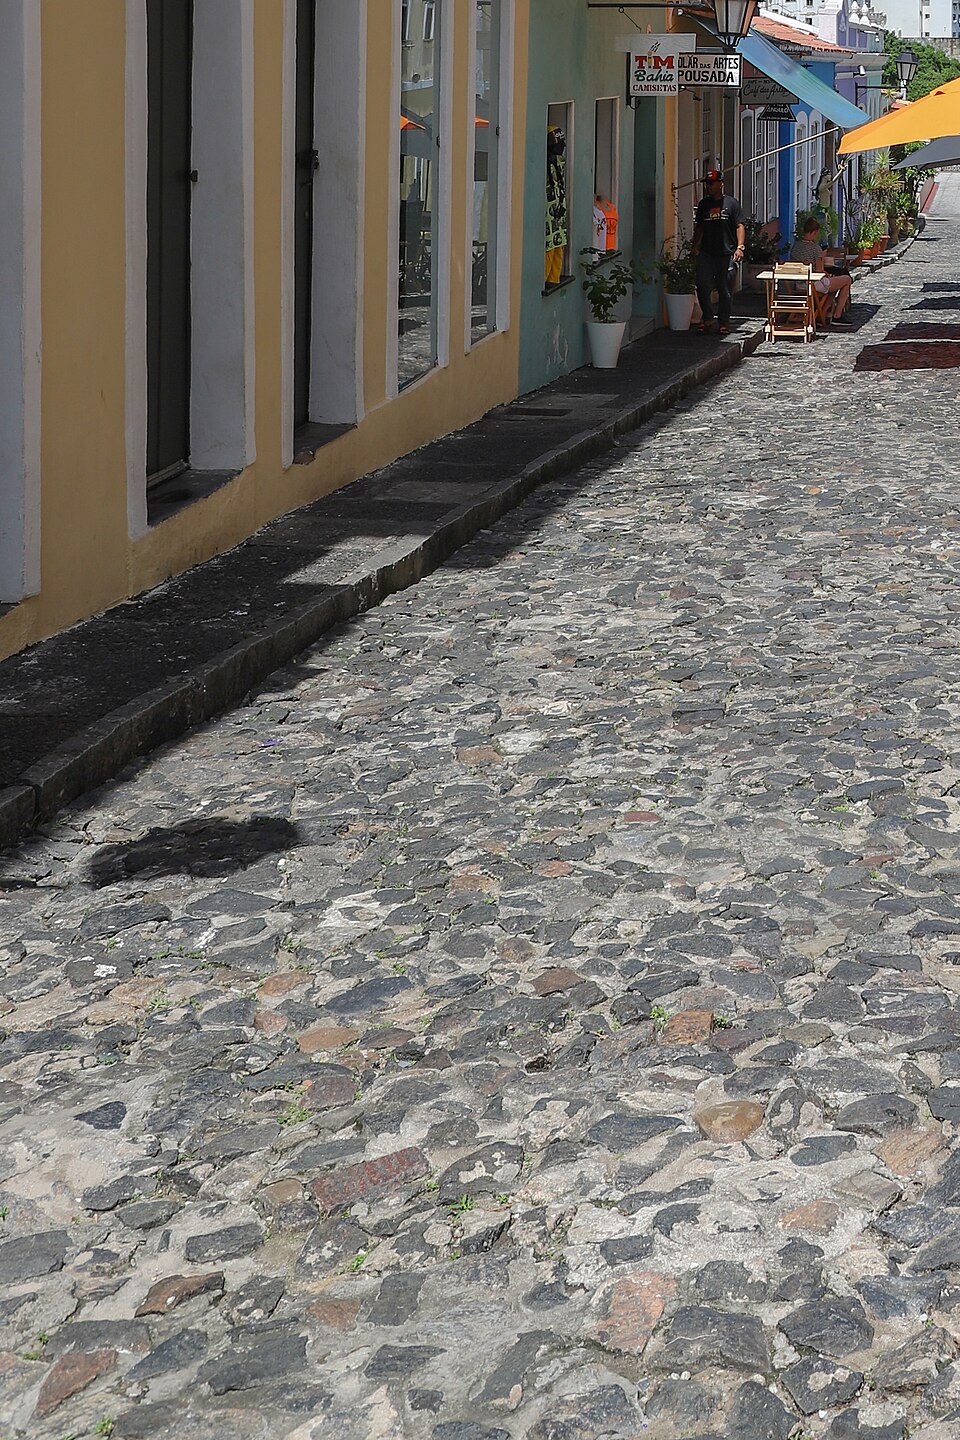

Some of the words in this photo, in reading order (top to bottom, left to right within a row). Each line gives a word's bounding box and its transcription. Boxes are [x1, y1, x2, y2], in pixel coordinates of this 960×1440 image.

[713, 56, 739, 69] ARTES
[634, 69, 674, 82] Bahia
[678, 70, 735, 83] POUSADA
[633, 84, 677, 92] CAMISETAS
